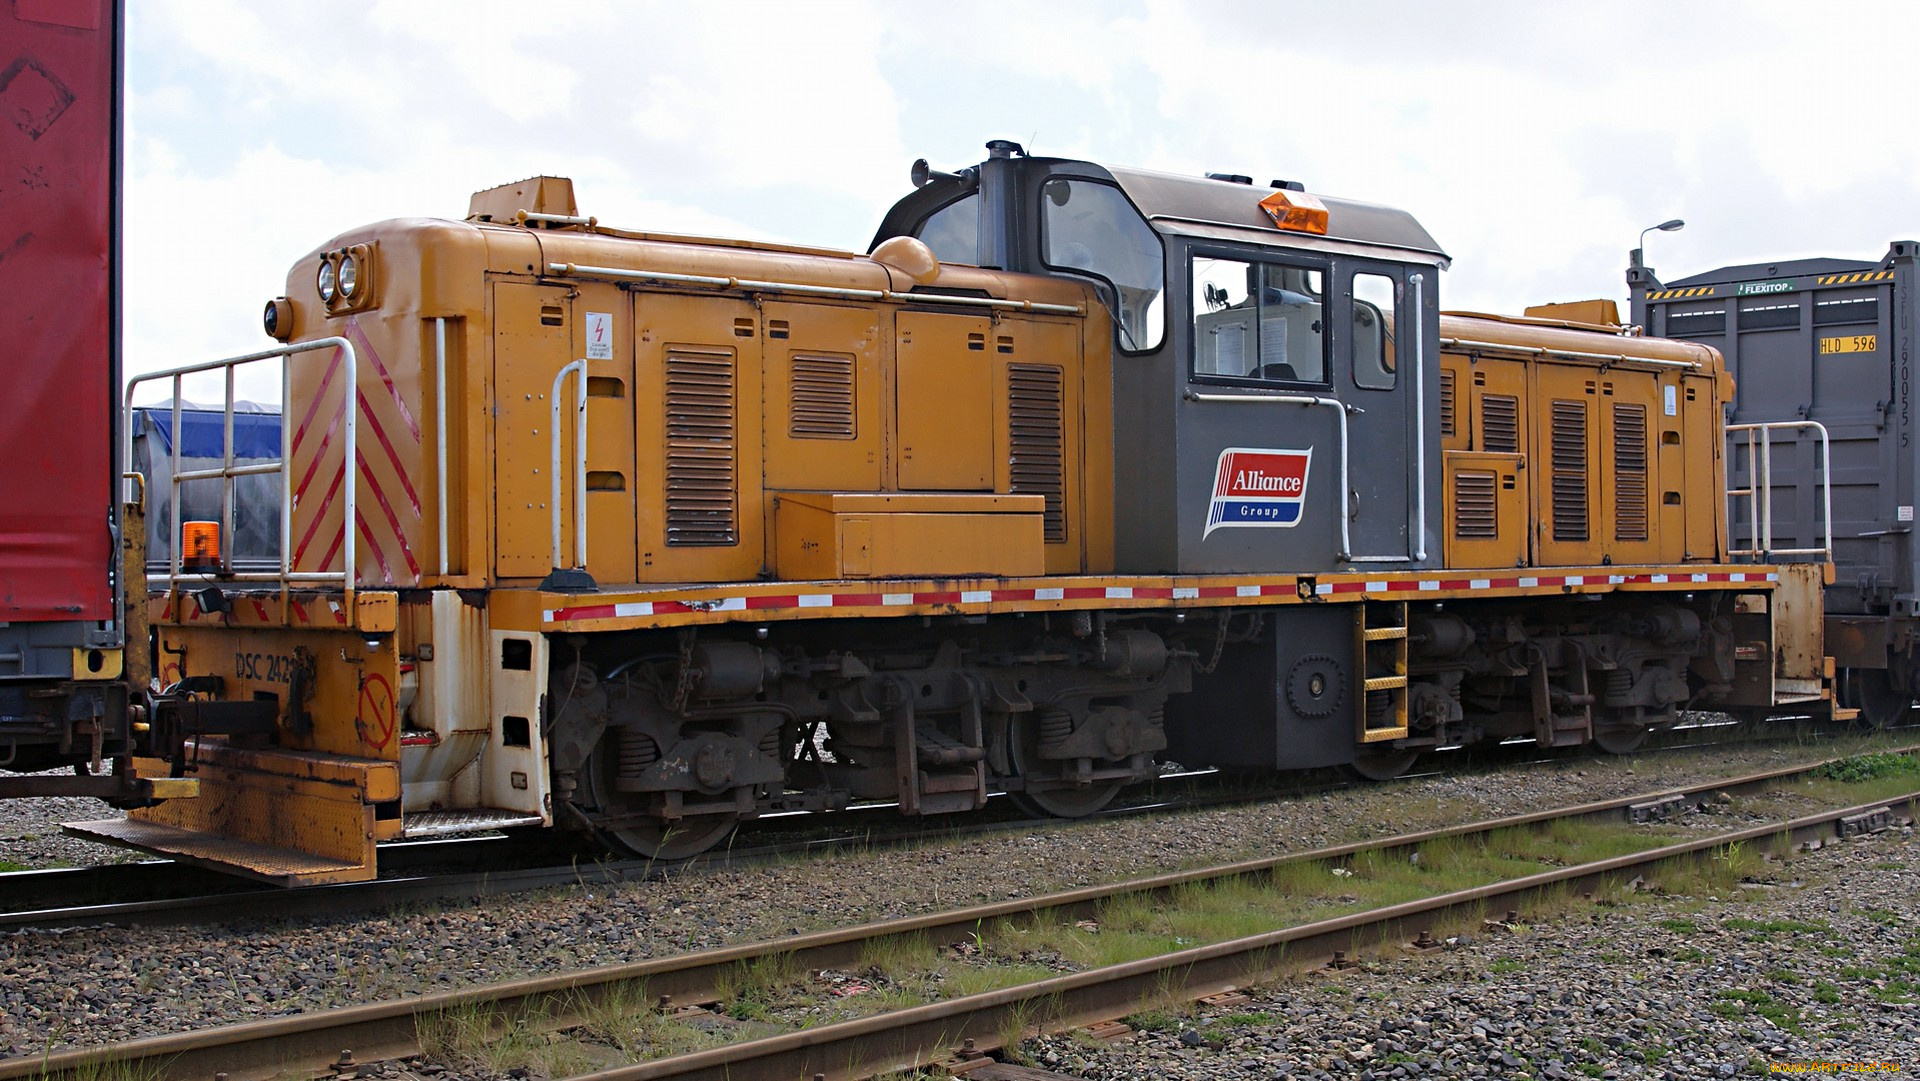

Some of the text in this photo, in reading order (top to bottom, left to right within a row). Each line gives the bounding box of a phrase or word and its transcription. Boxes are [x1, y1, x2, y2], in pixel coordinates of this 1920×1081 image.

[1745, 283, 1788, 294] FLEXITOP
[1821, 336, 1875, 353] HLD 596
[1232, 470, 1301, 492] Alliance
[1240, 505, 1279, 518] Group
[236, 653, 297, 684] DSC 242
